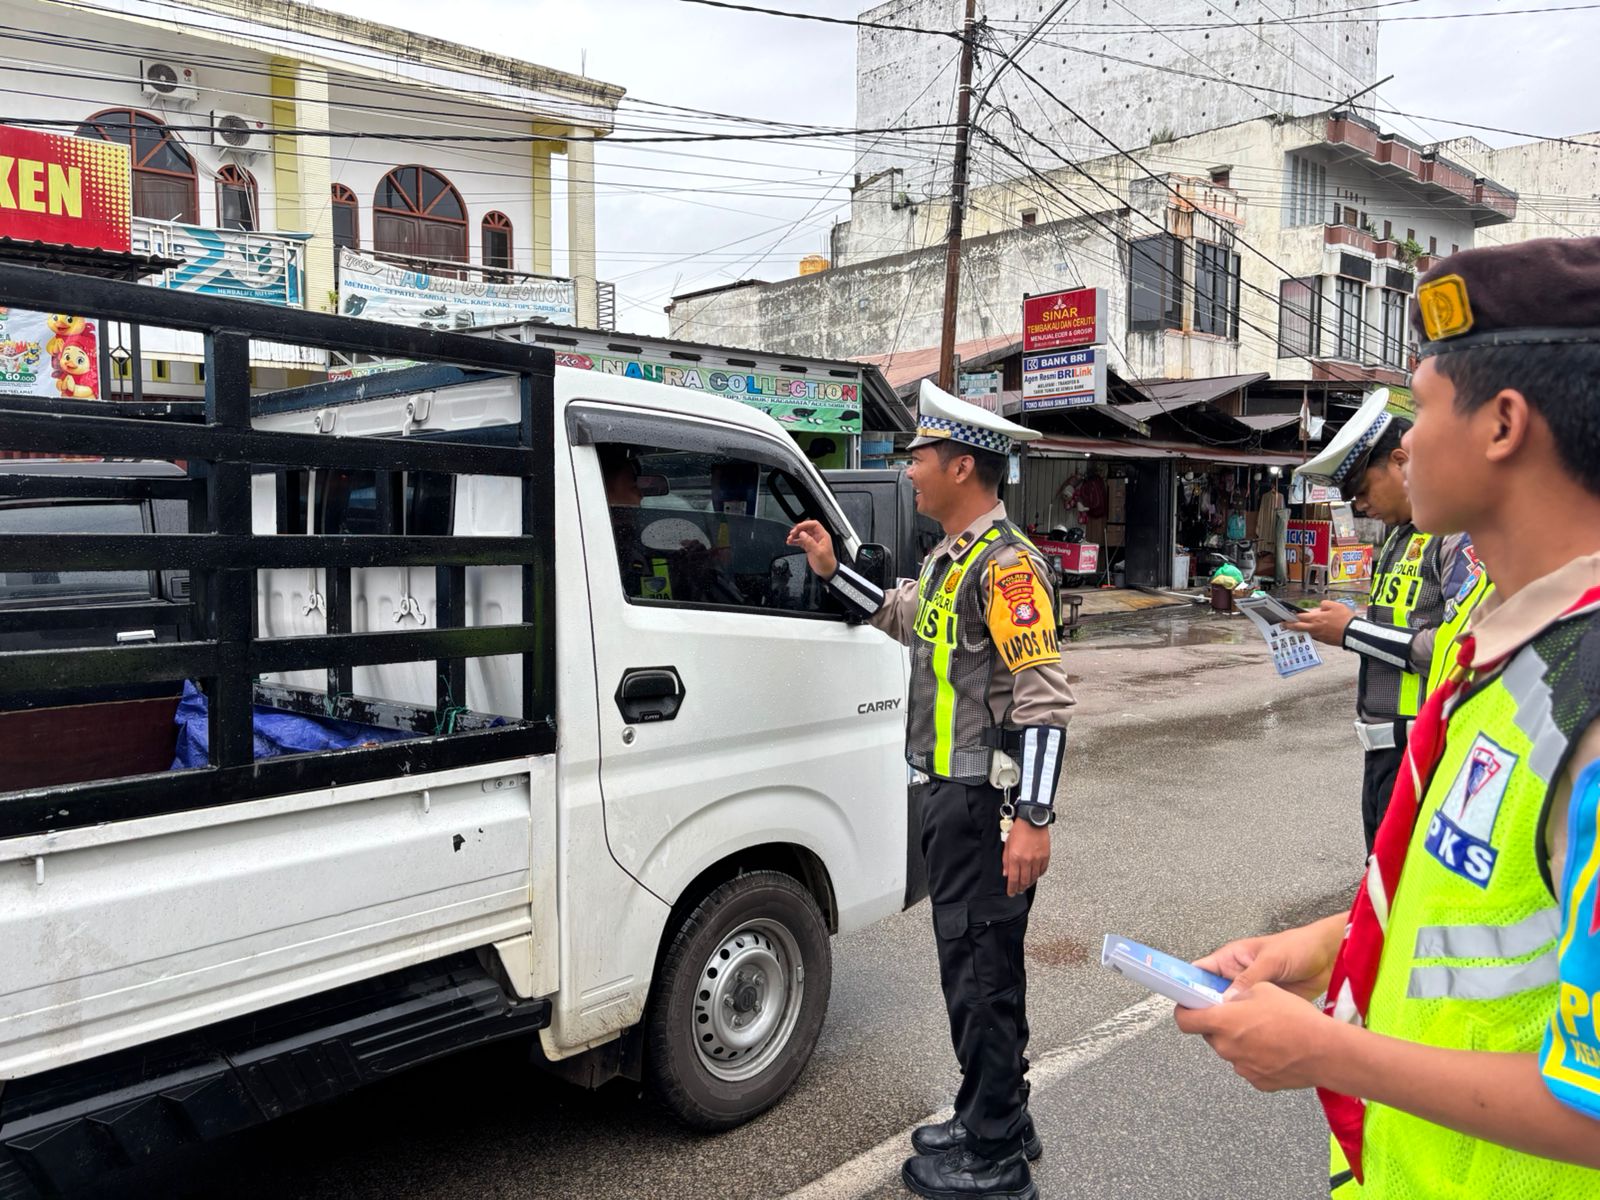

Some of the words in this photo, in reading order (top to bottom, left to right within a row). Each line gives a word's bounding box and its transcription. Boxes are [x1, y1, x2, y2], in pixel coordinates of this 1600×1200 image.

[386, 267, 457, 293] NAURA
[461, 280, 570, 304] COLLECTION
[1042, 307, 1078, 322] SINAR
[1027, 322, 1060, 334] TEMBAKAU
[1060, 320, 1072, 328] DAN
[1073, 327, 1093, 336] GROSIR
[1041, 356, 1068, 367] BANK
[1070, 353, 1086, 363] BRI
[602, 359, 704, 389] NAURA
[708, 372, 858, 401] COLLECTION
[1024, 374, 1039, 384] Agen
[1057, 366, 1092, 379] BRILink
[1026, 401, 1037, 409] TOKO
[1068, 395, 1093, 404] TEMBAKAU
[1394, 563, 1418, 577] POLRI
[934, 593, 954, 612] POLRI
[1002, 631, 1041, 665] KAPOS
[857, 698, 901, 714] CARRY
[1429, 815, 1492, 881] PKS
